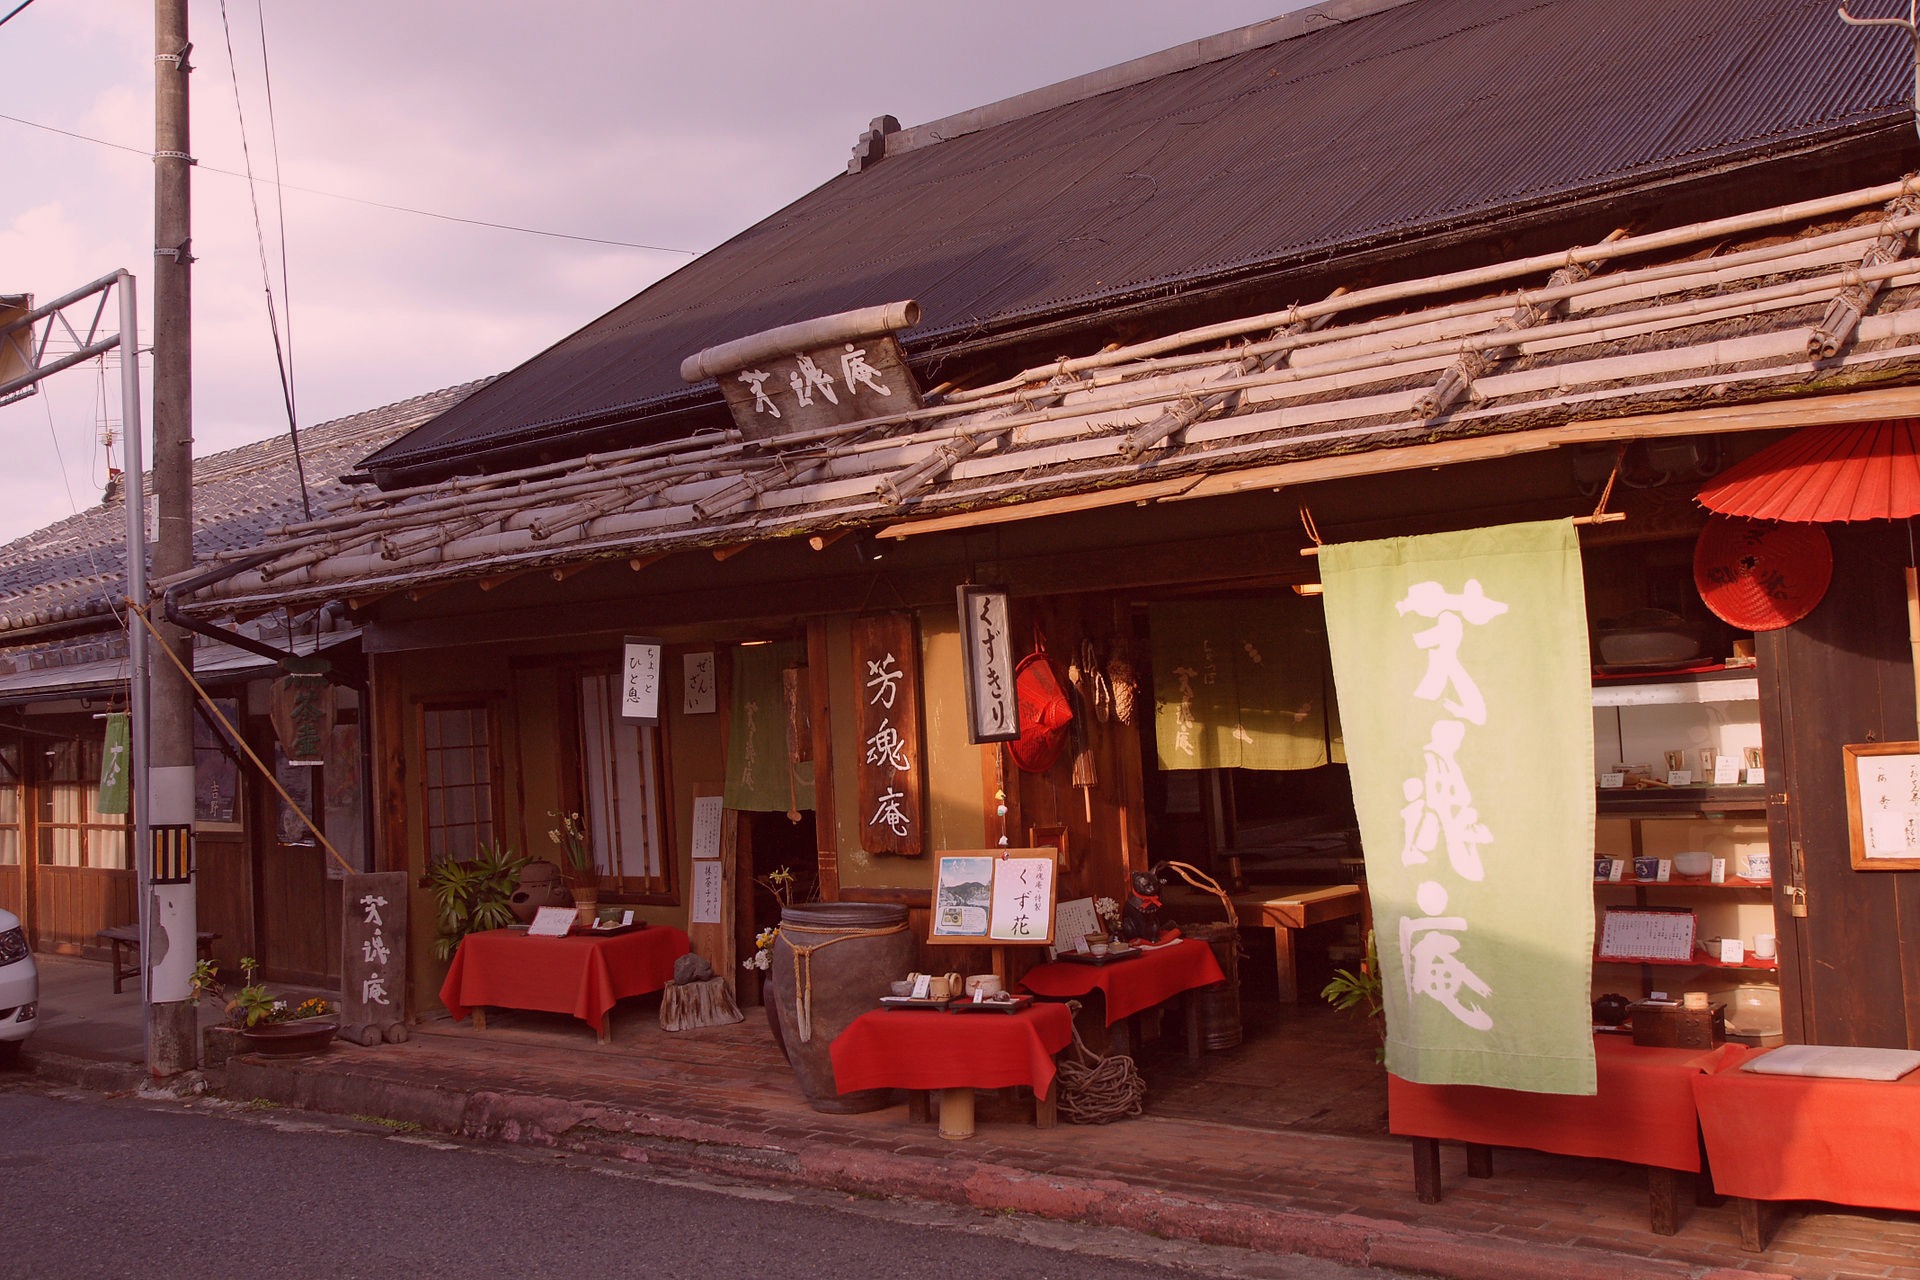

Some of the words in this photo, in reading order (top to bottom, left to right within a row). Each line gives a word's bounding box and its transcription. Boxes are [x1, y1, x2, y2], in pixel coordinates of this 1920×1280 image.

[626, 657, 641, 703] ひと息
[645, 648, 655, 693] ちょっと
[980, 597, 1005, 728] くずきり
[867, 652, 911, 836] 芳魂庵
[1011, 868, 1032, 935] くず花
